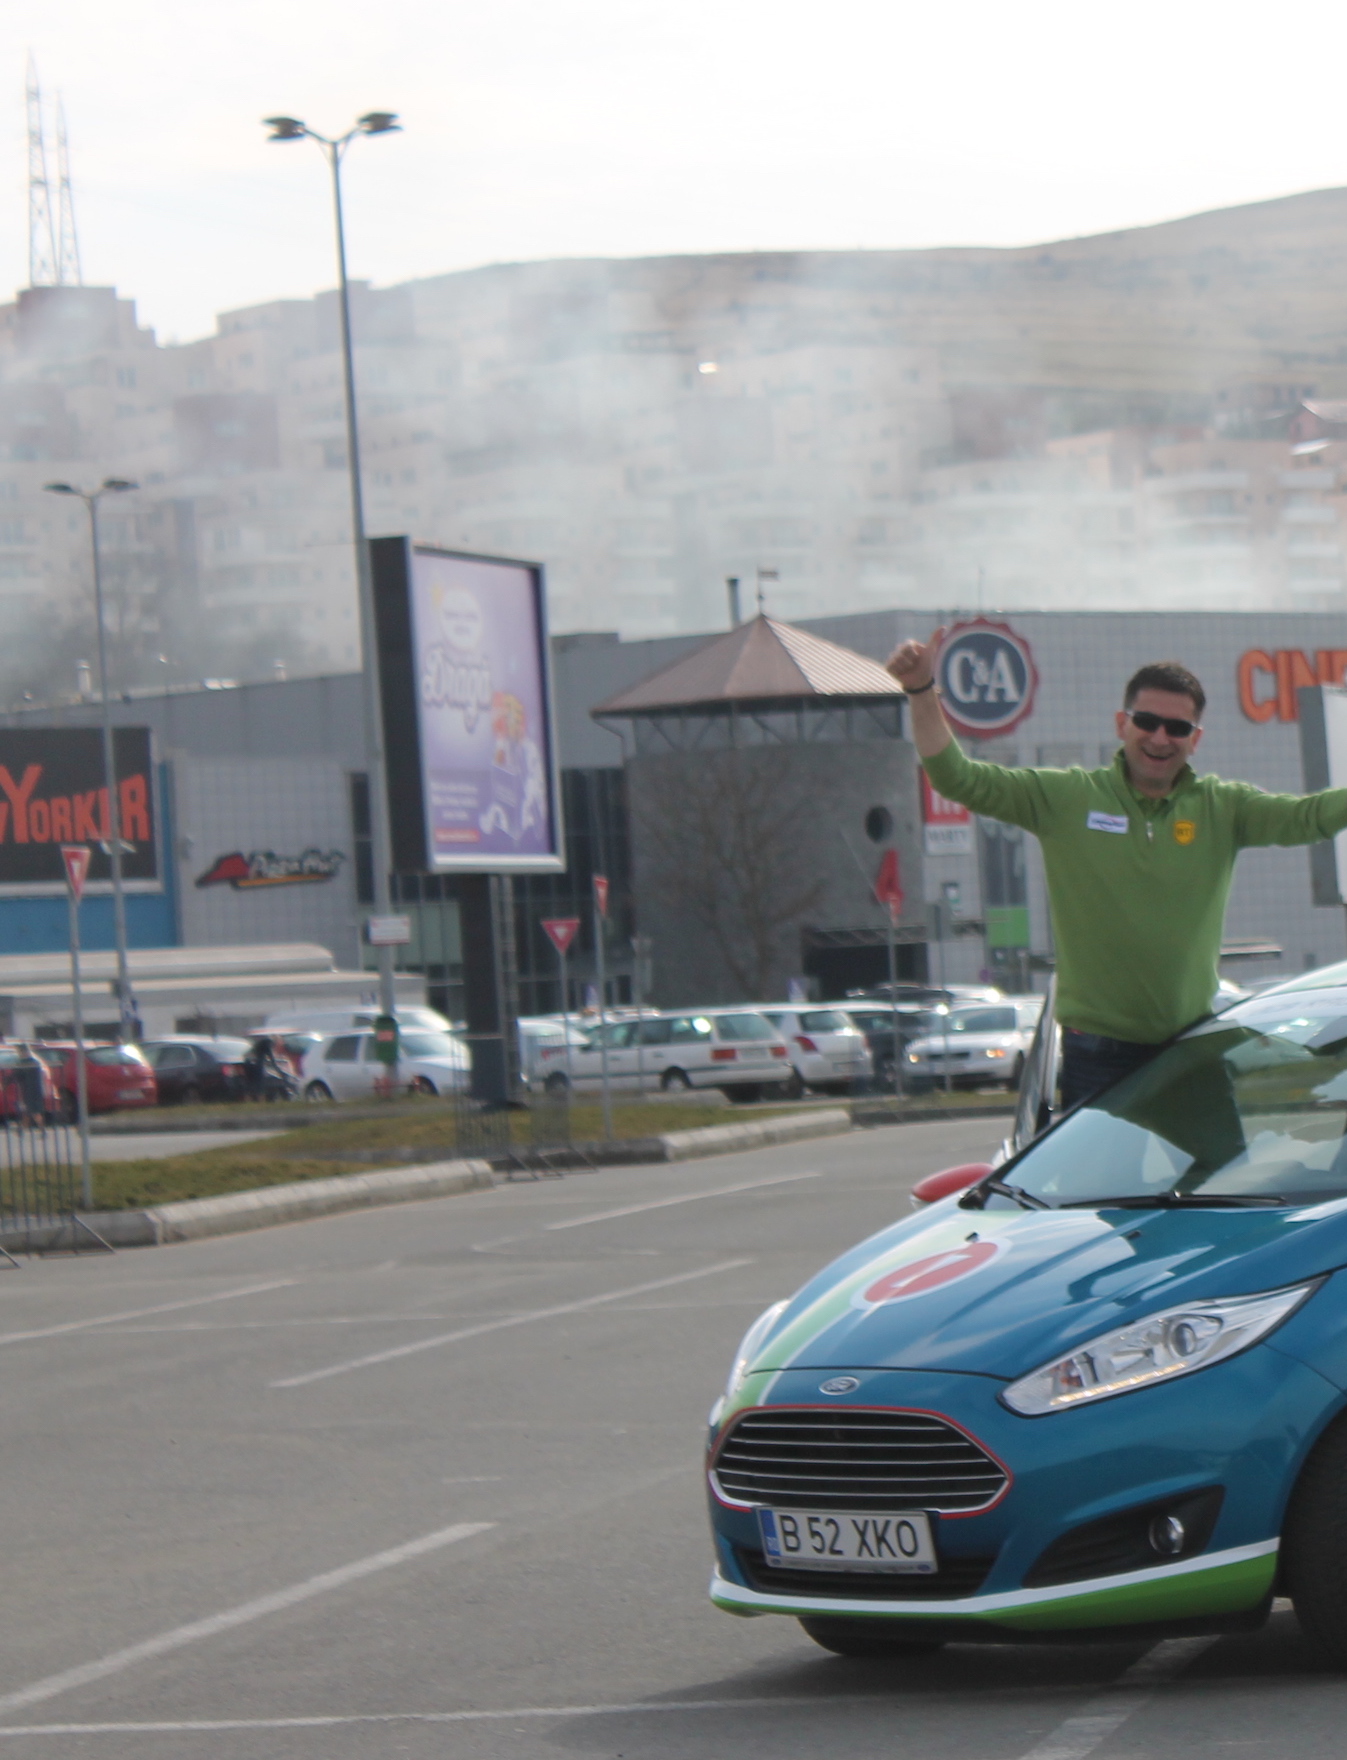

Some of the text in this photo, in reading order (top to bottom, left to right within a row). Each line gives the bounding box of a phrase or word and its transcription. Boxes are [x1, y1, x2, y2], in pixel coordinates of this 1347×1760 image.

[947, 649, 1020, 704] C&A
[778, 1514, 919, 1558] B 52 XKO
